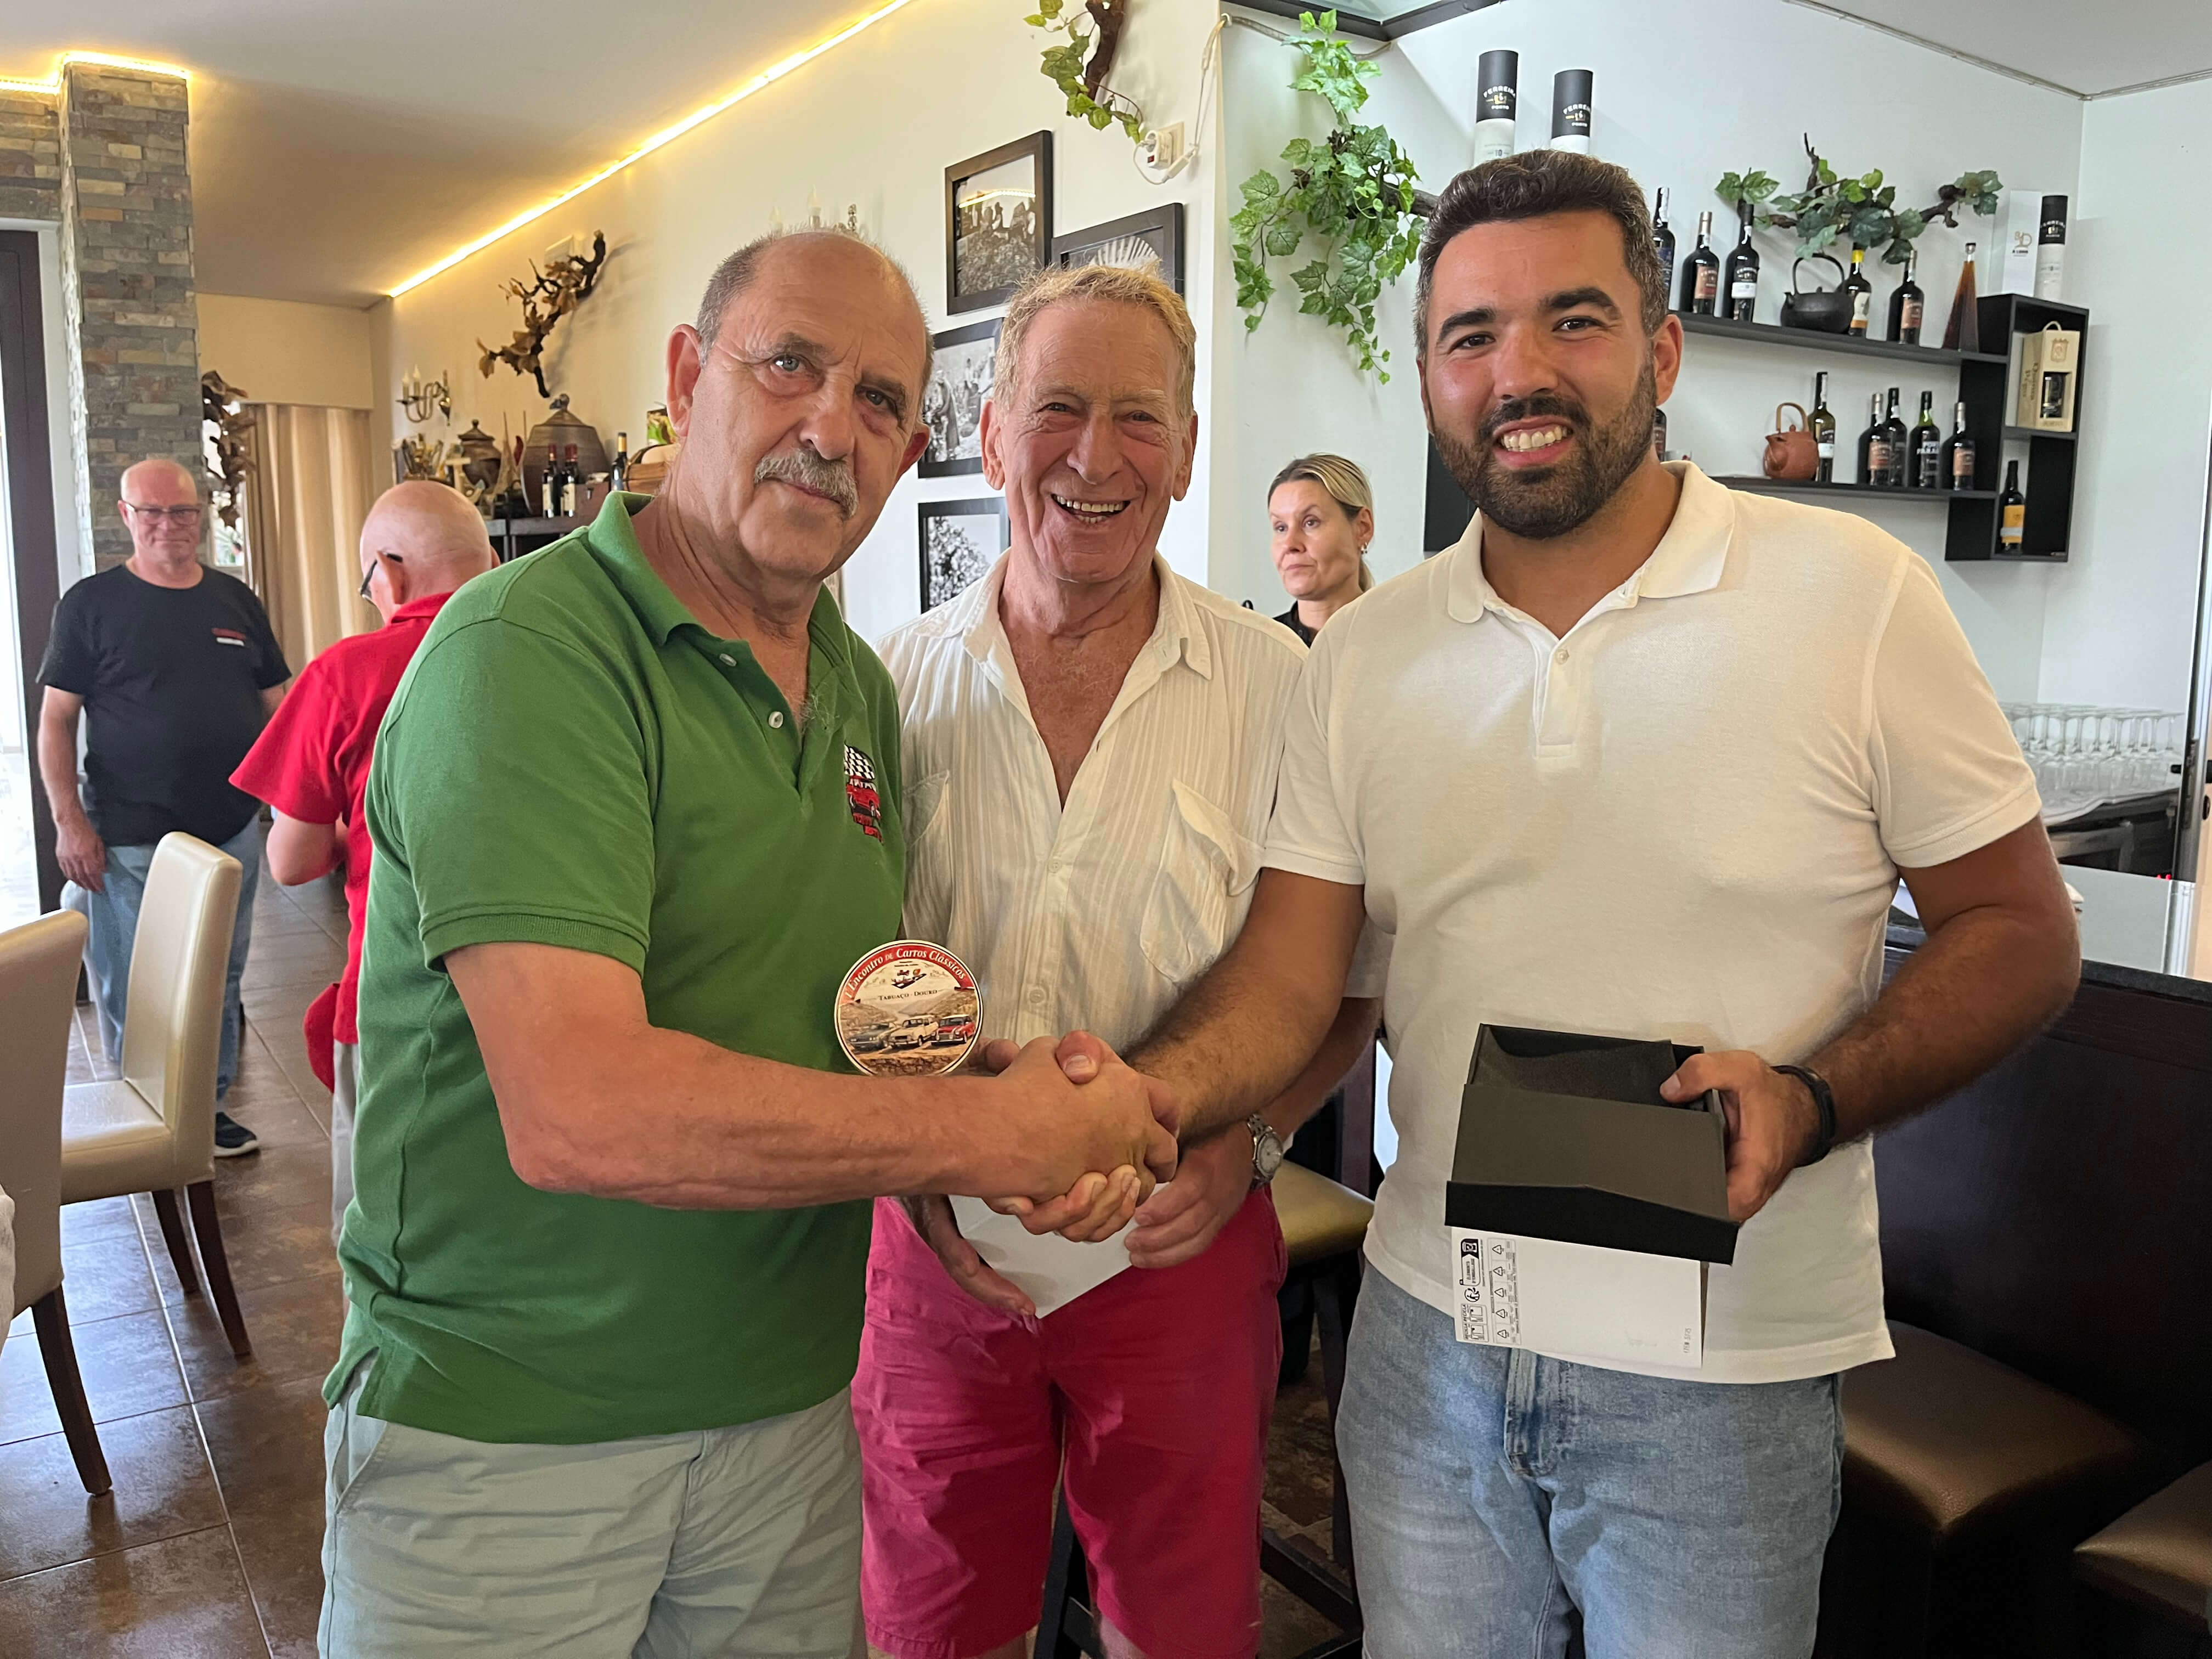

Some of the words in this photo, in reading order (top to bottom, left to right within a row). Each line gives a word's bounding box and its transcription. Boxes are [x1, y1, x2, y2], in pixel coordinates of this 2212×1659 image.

[848, 956, 884, 991] Encontro
[896, 948, 927, 958] Carros
[928, 950, 966, 980] Clássicos
[878, 992, 910, 1001] TABUAÇO
